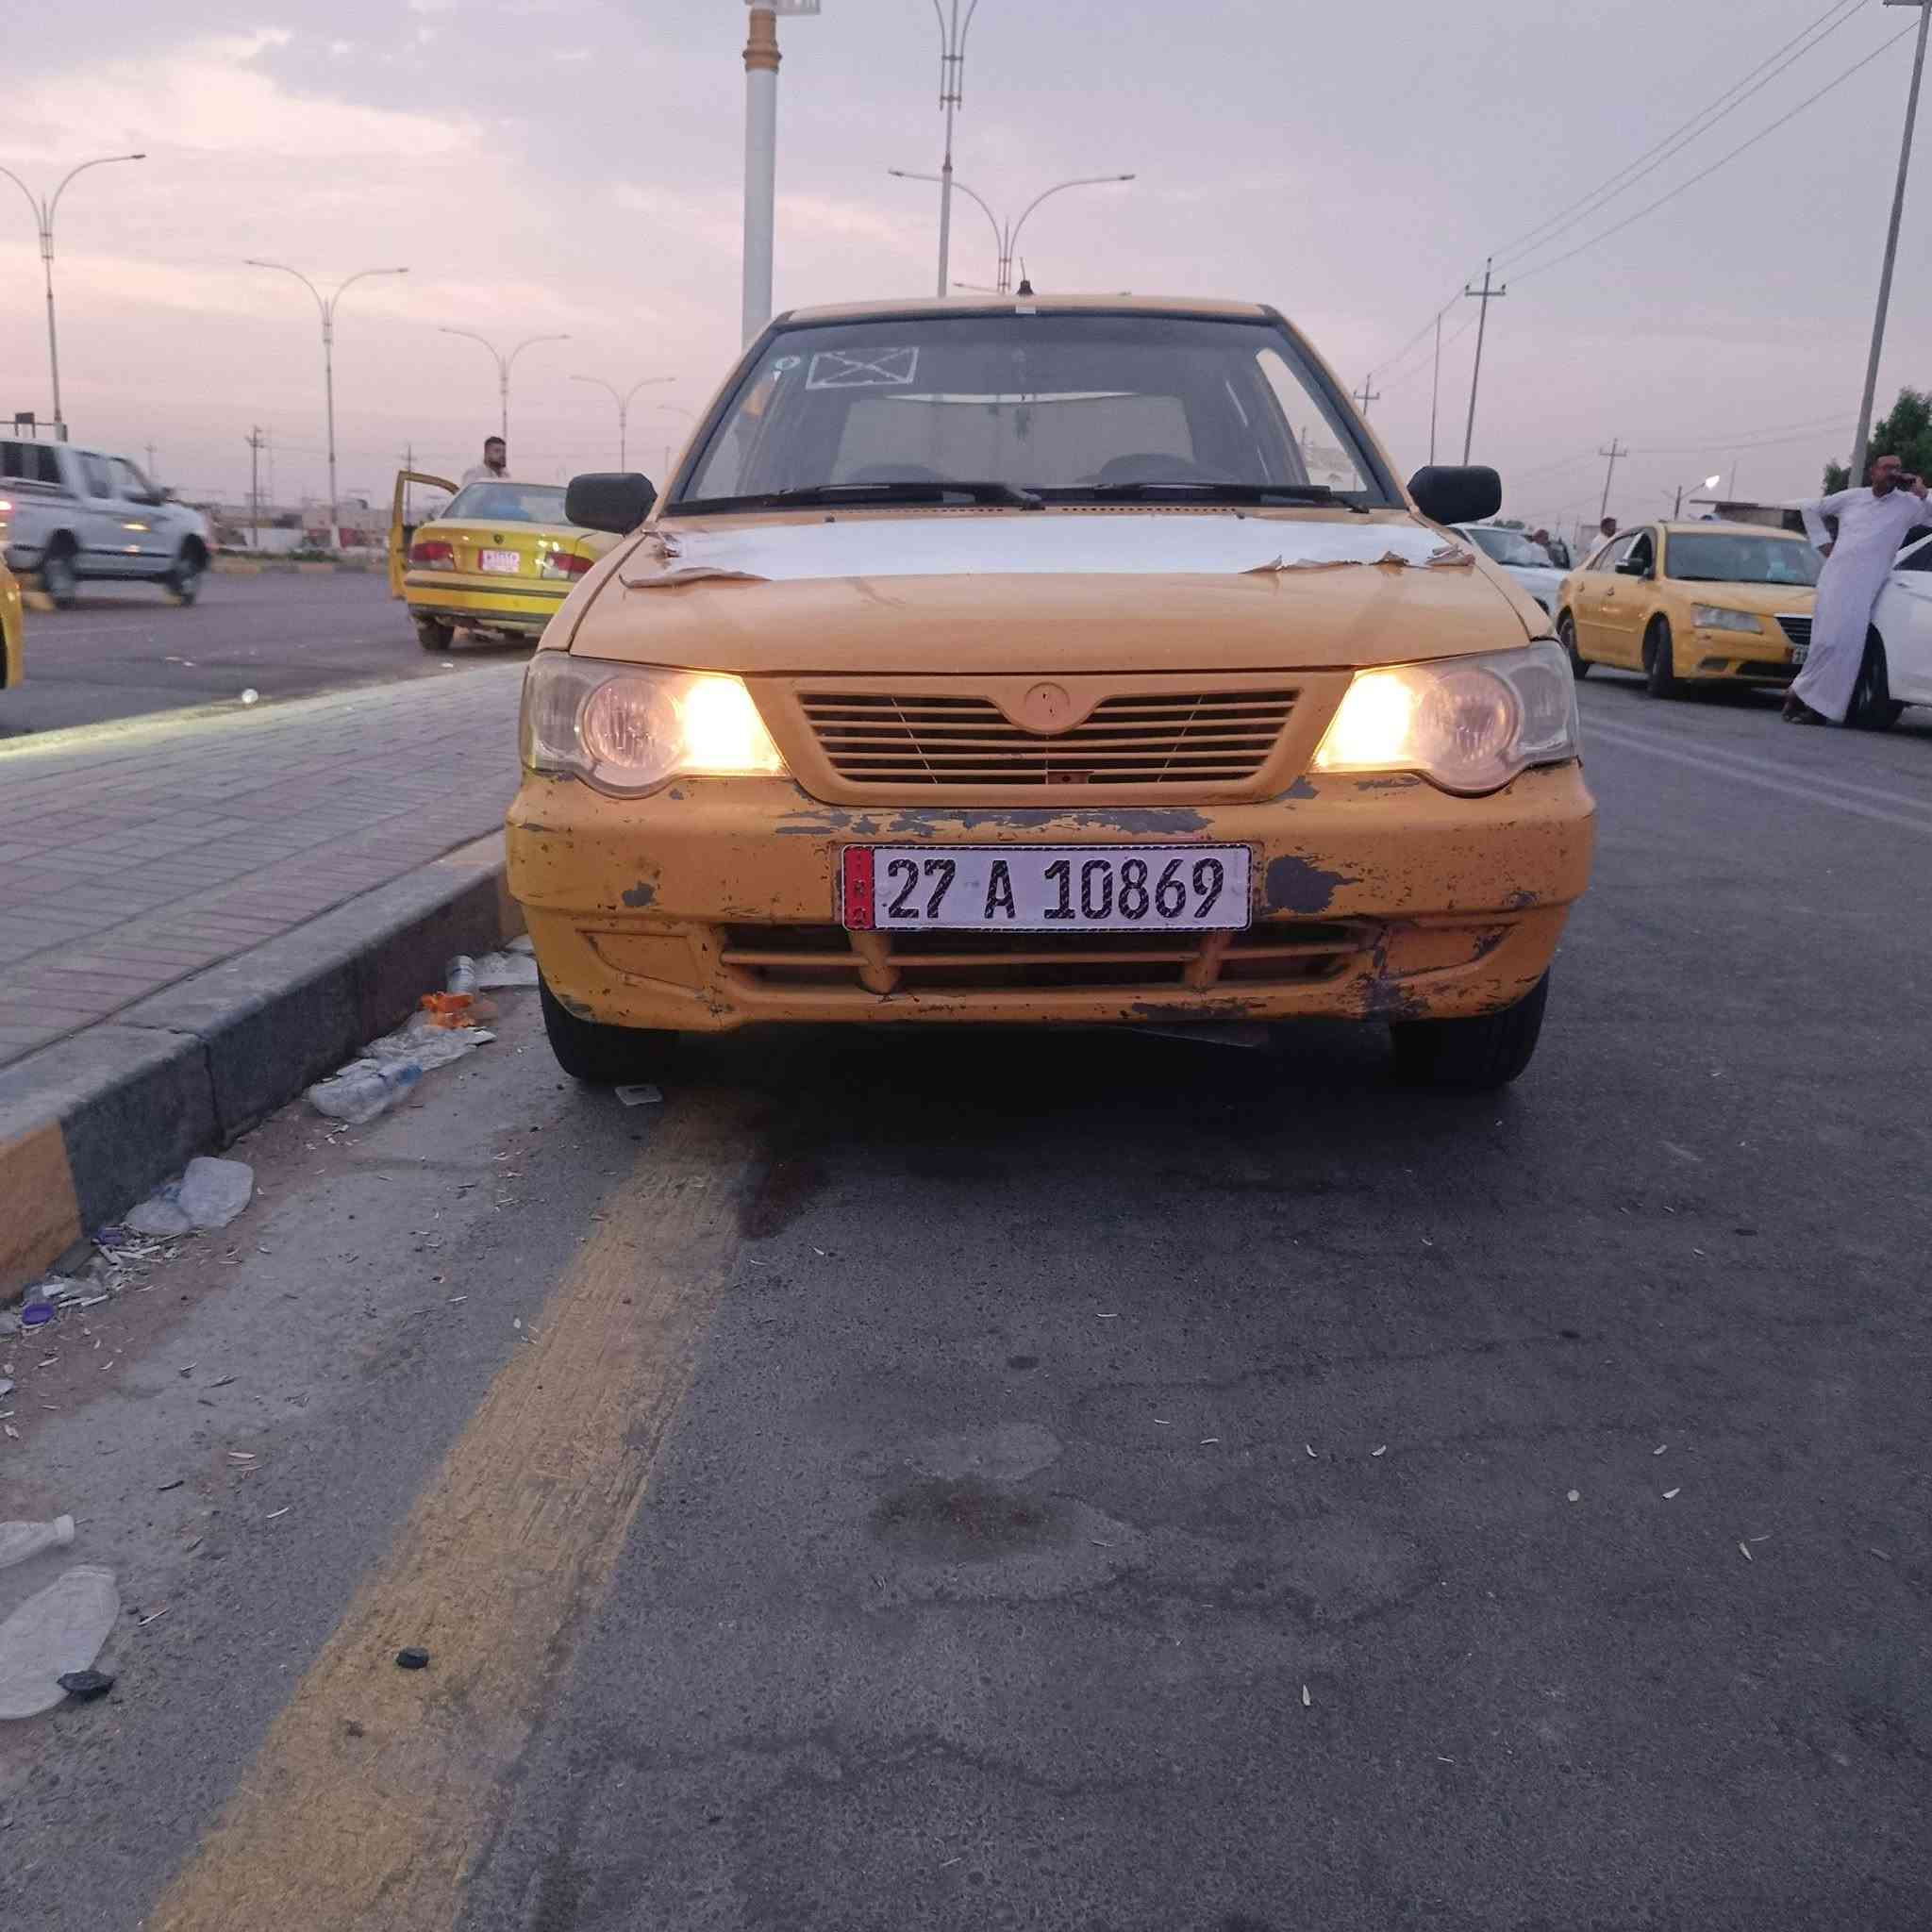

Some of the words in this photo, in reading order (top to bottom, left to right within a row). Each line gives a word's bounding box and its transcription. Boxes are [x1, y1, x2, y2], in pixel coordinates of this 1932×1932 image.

[888, 859, 956, 919] 27
[984, 859, 1016, 919] A
[1044, 858, 1224, 920] 10869
